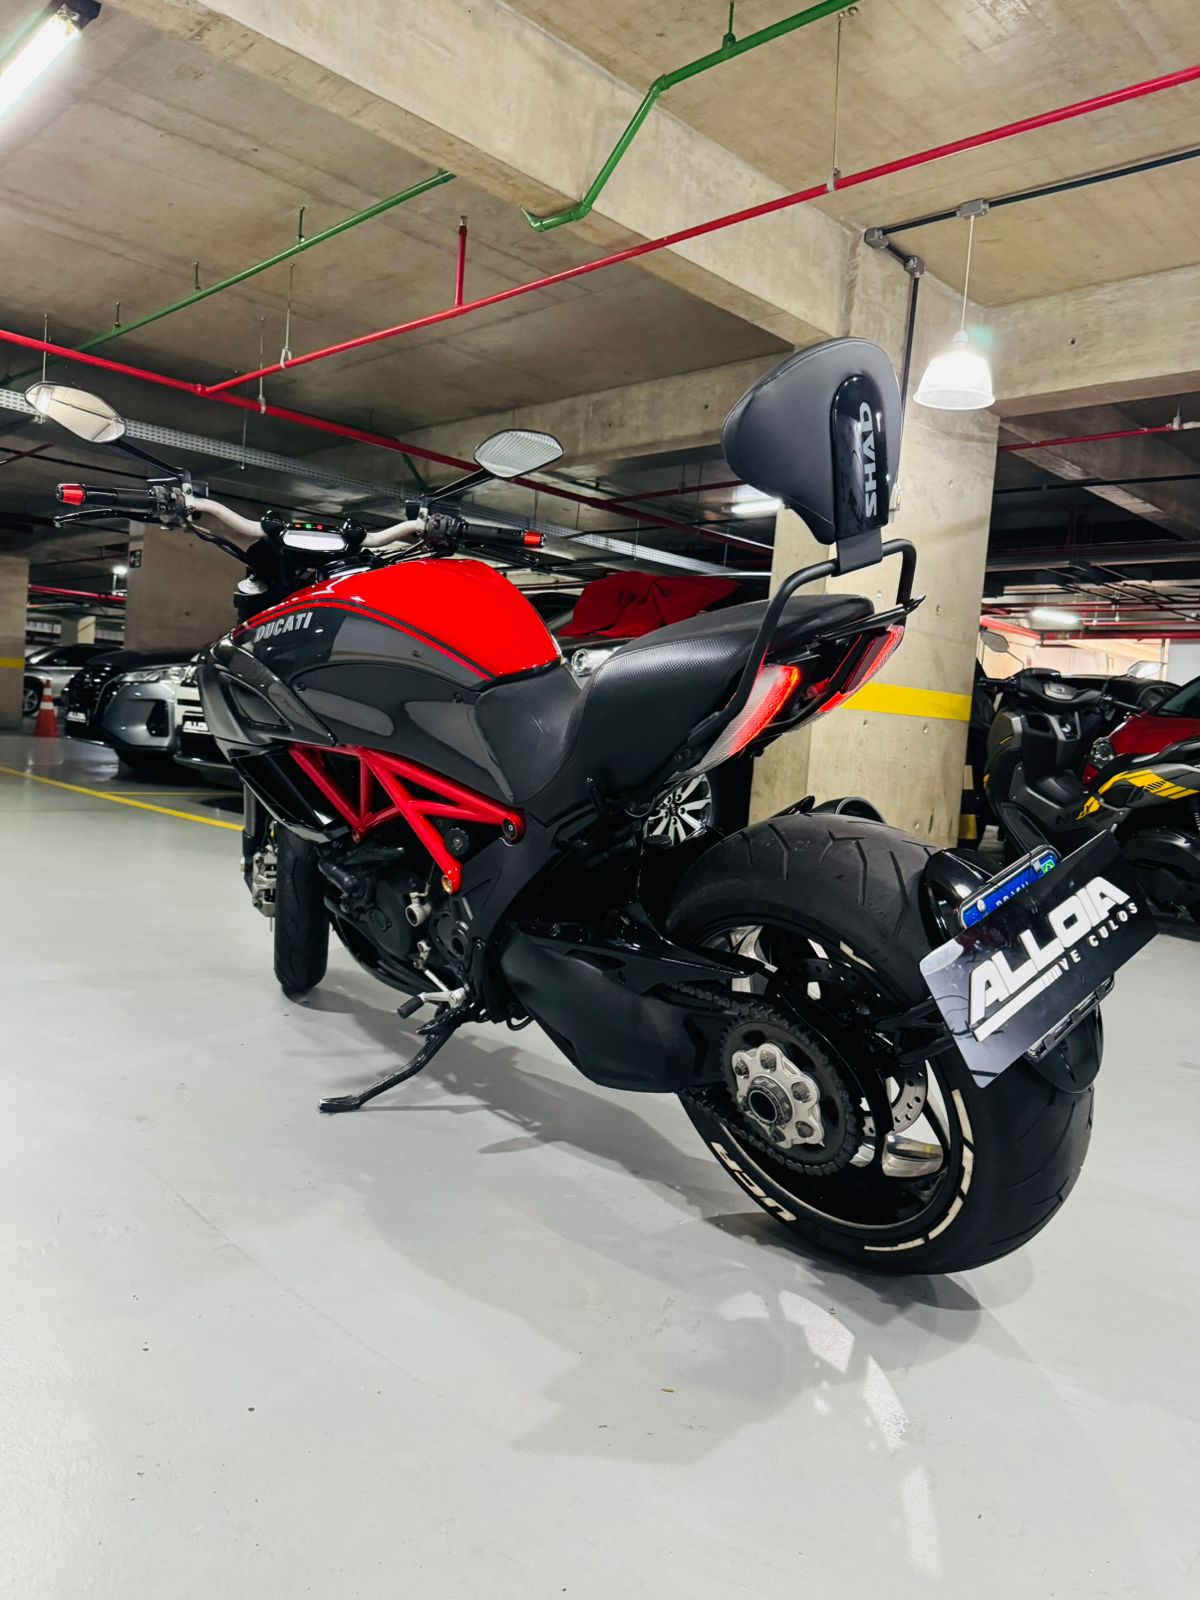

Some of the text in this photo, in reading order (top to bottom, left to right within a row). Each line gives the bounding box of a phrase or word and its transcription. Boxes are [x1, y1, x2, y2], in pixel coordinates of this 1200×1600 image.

[859, 401, 877, 518] SHAD
[253, 611, 314, 643] DUCATI
[969, 876, 1131, 1026] ALLOIA
